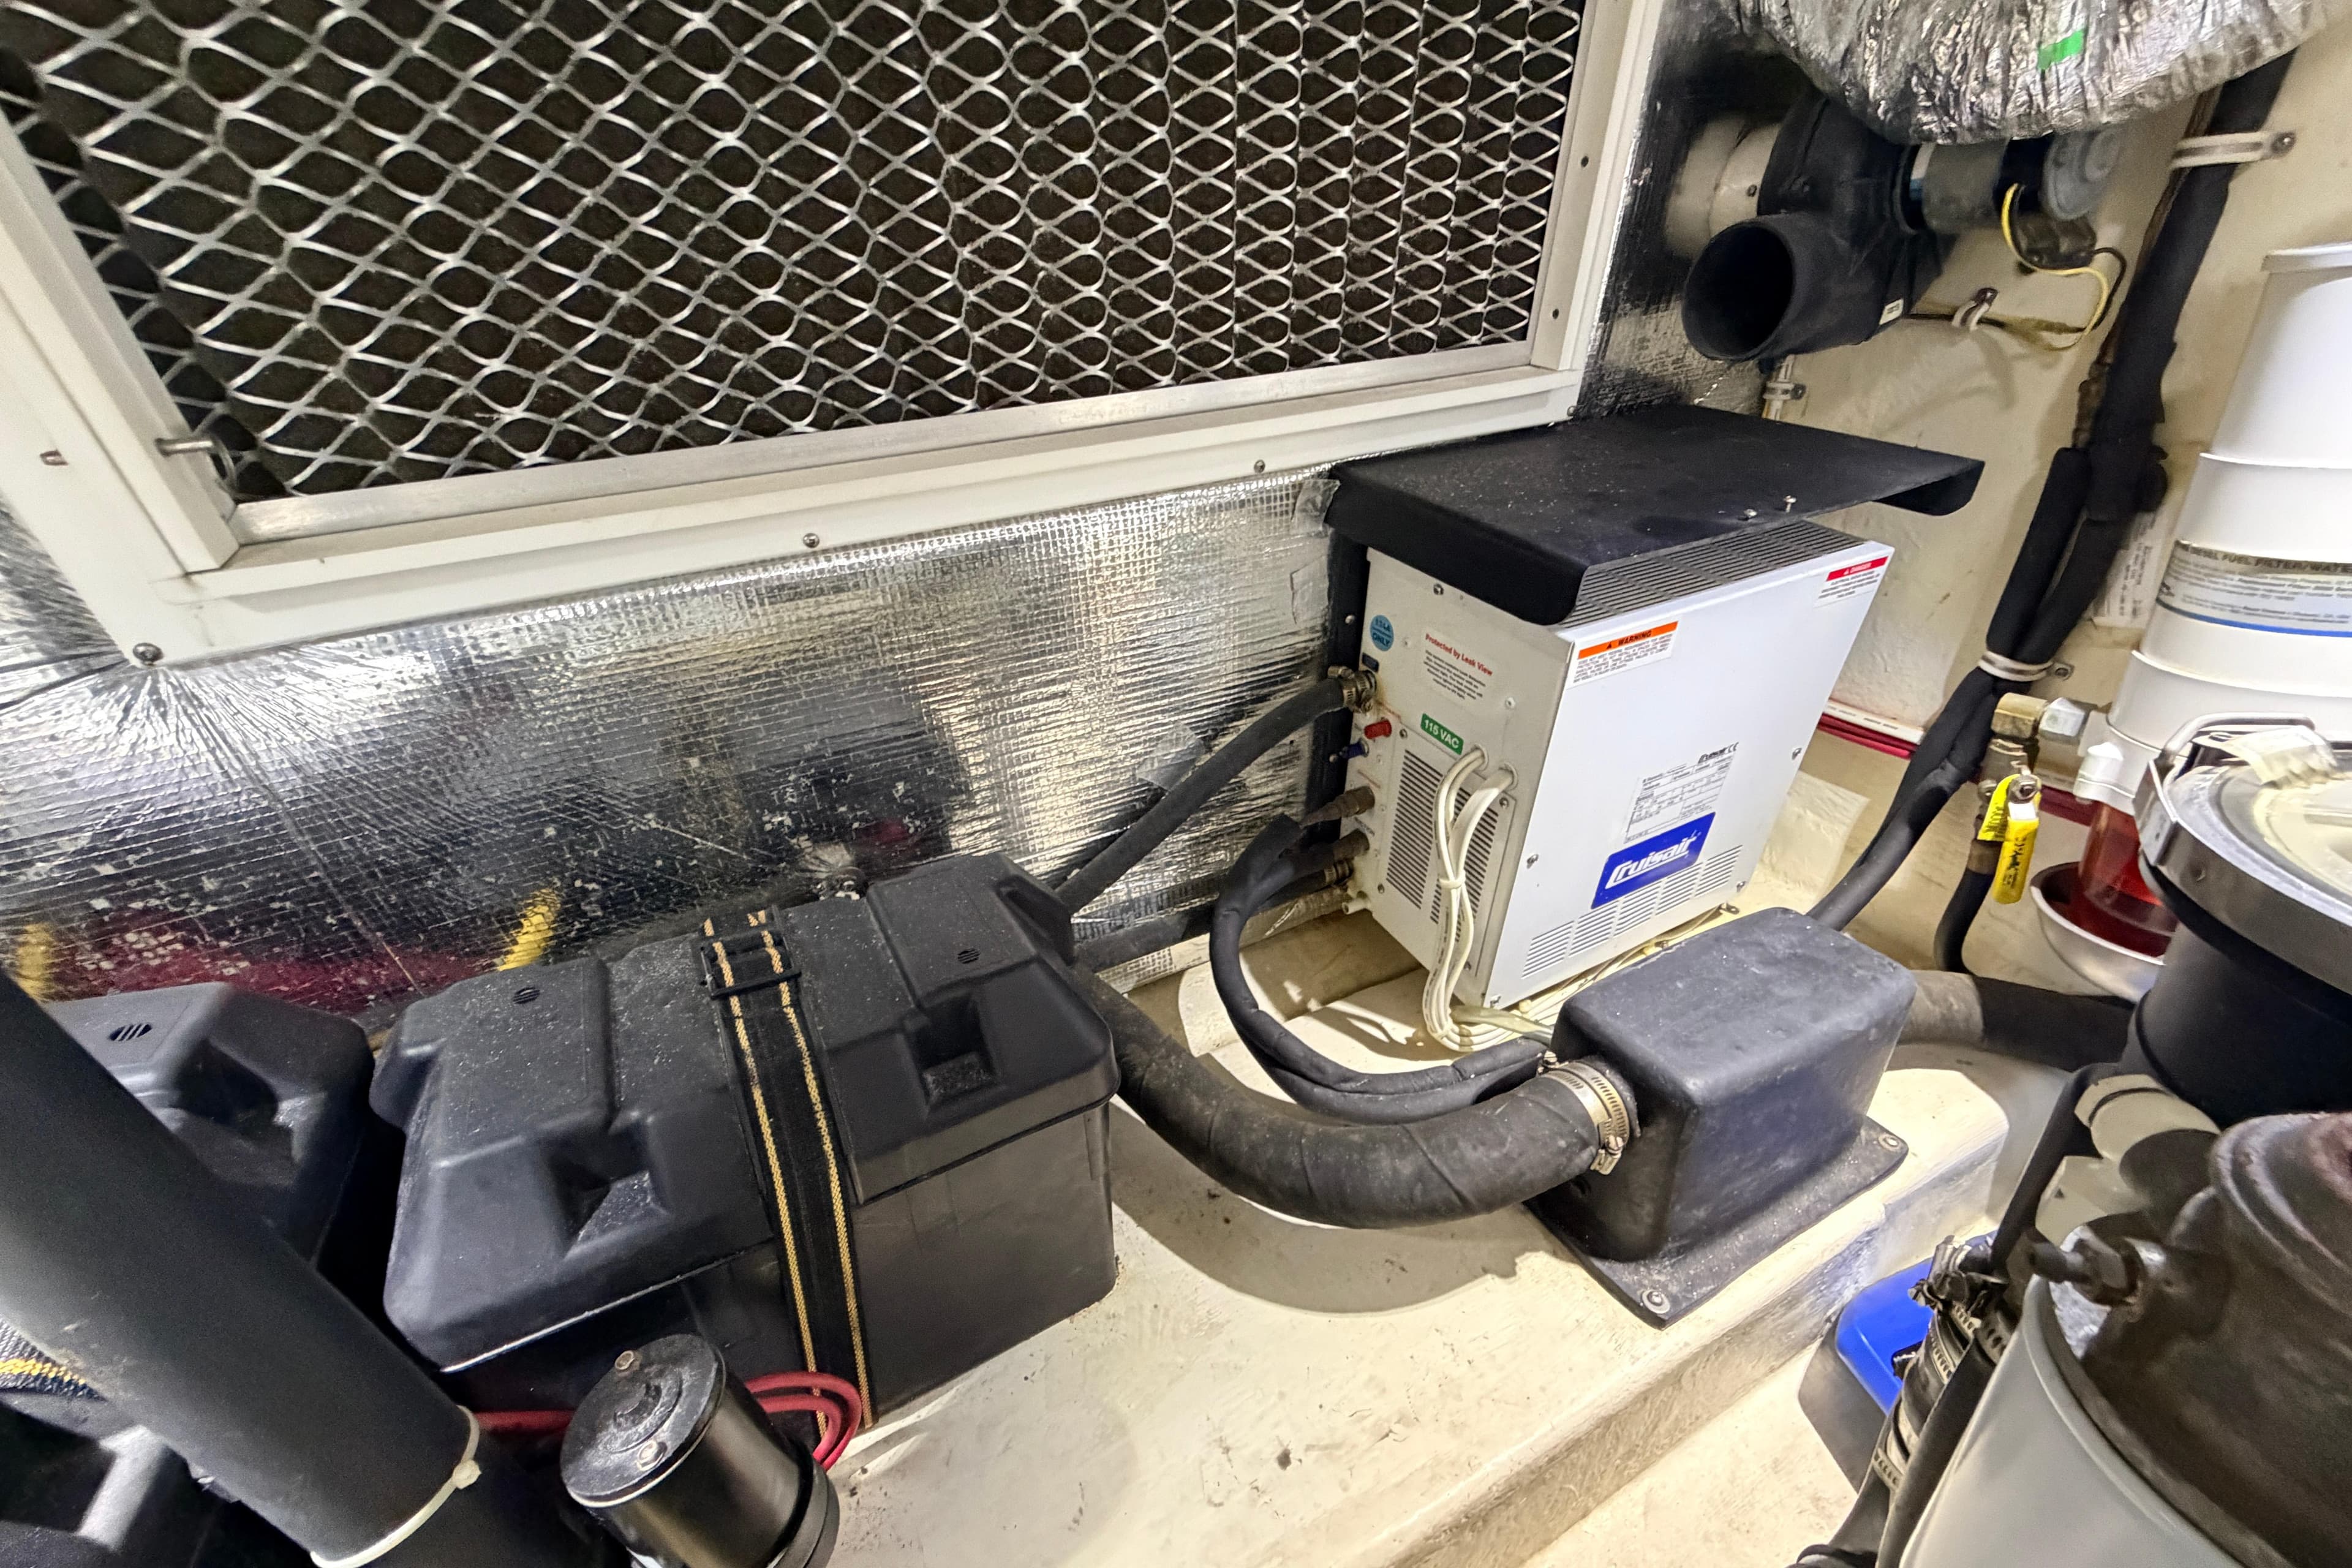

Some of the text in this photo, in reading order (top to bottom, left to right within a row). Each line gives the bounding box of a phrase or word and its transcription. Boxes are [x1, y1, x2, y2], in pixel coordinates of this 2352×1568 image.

[1372, 633, 1390, 647] ONLY
[1618, 630, 1652, 646] WARNING
[1425, 633, 1493, 676] Protected by Leak View
[1424, 720, 1460, 749] 115 VAC
[1605, 835, 1697, 889] Cruisair
